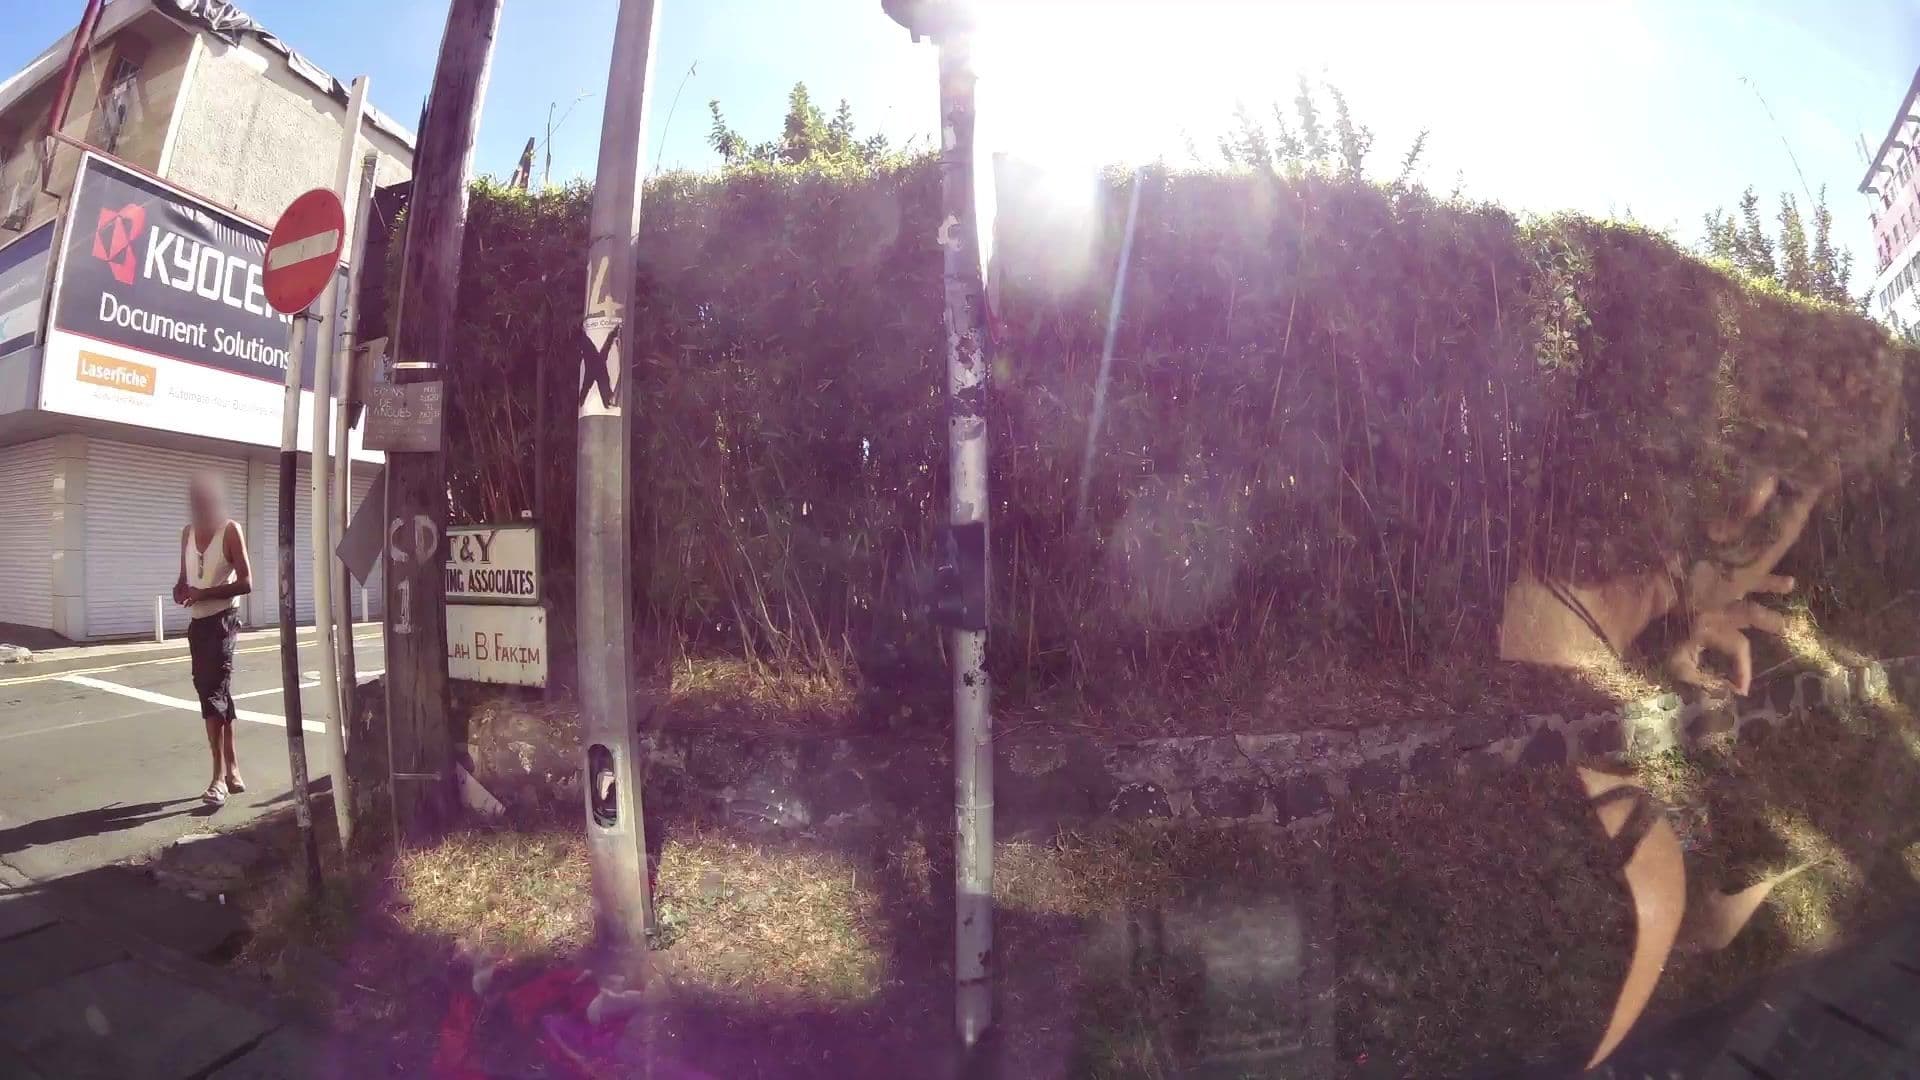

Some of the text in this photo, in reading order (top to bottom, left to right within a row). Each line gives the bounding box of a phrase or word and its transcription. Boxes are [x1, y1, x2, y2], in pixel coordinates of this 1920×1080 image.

[143, 225, 293, 325] KYOCE
[99, 292, 290, 370] Document Solutions
[80, 358, 149, 388] Laserfiche
[468, 568, 535, 595] ASSOCIATES
[447, 642, 470, 660] AH
